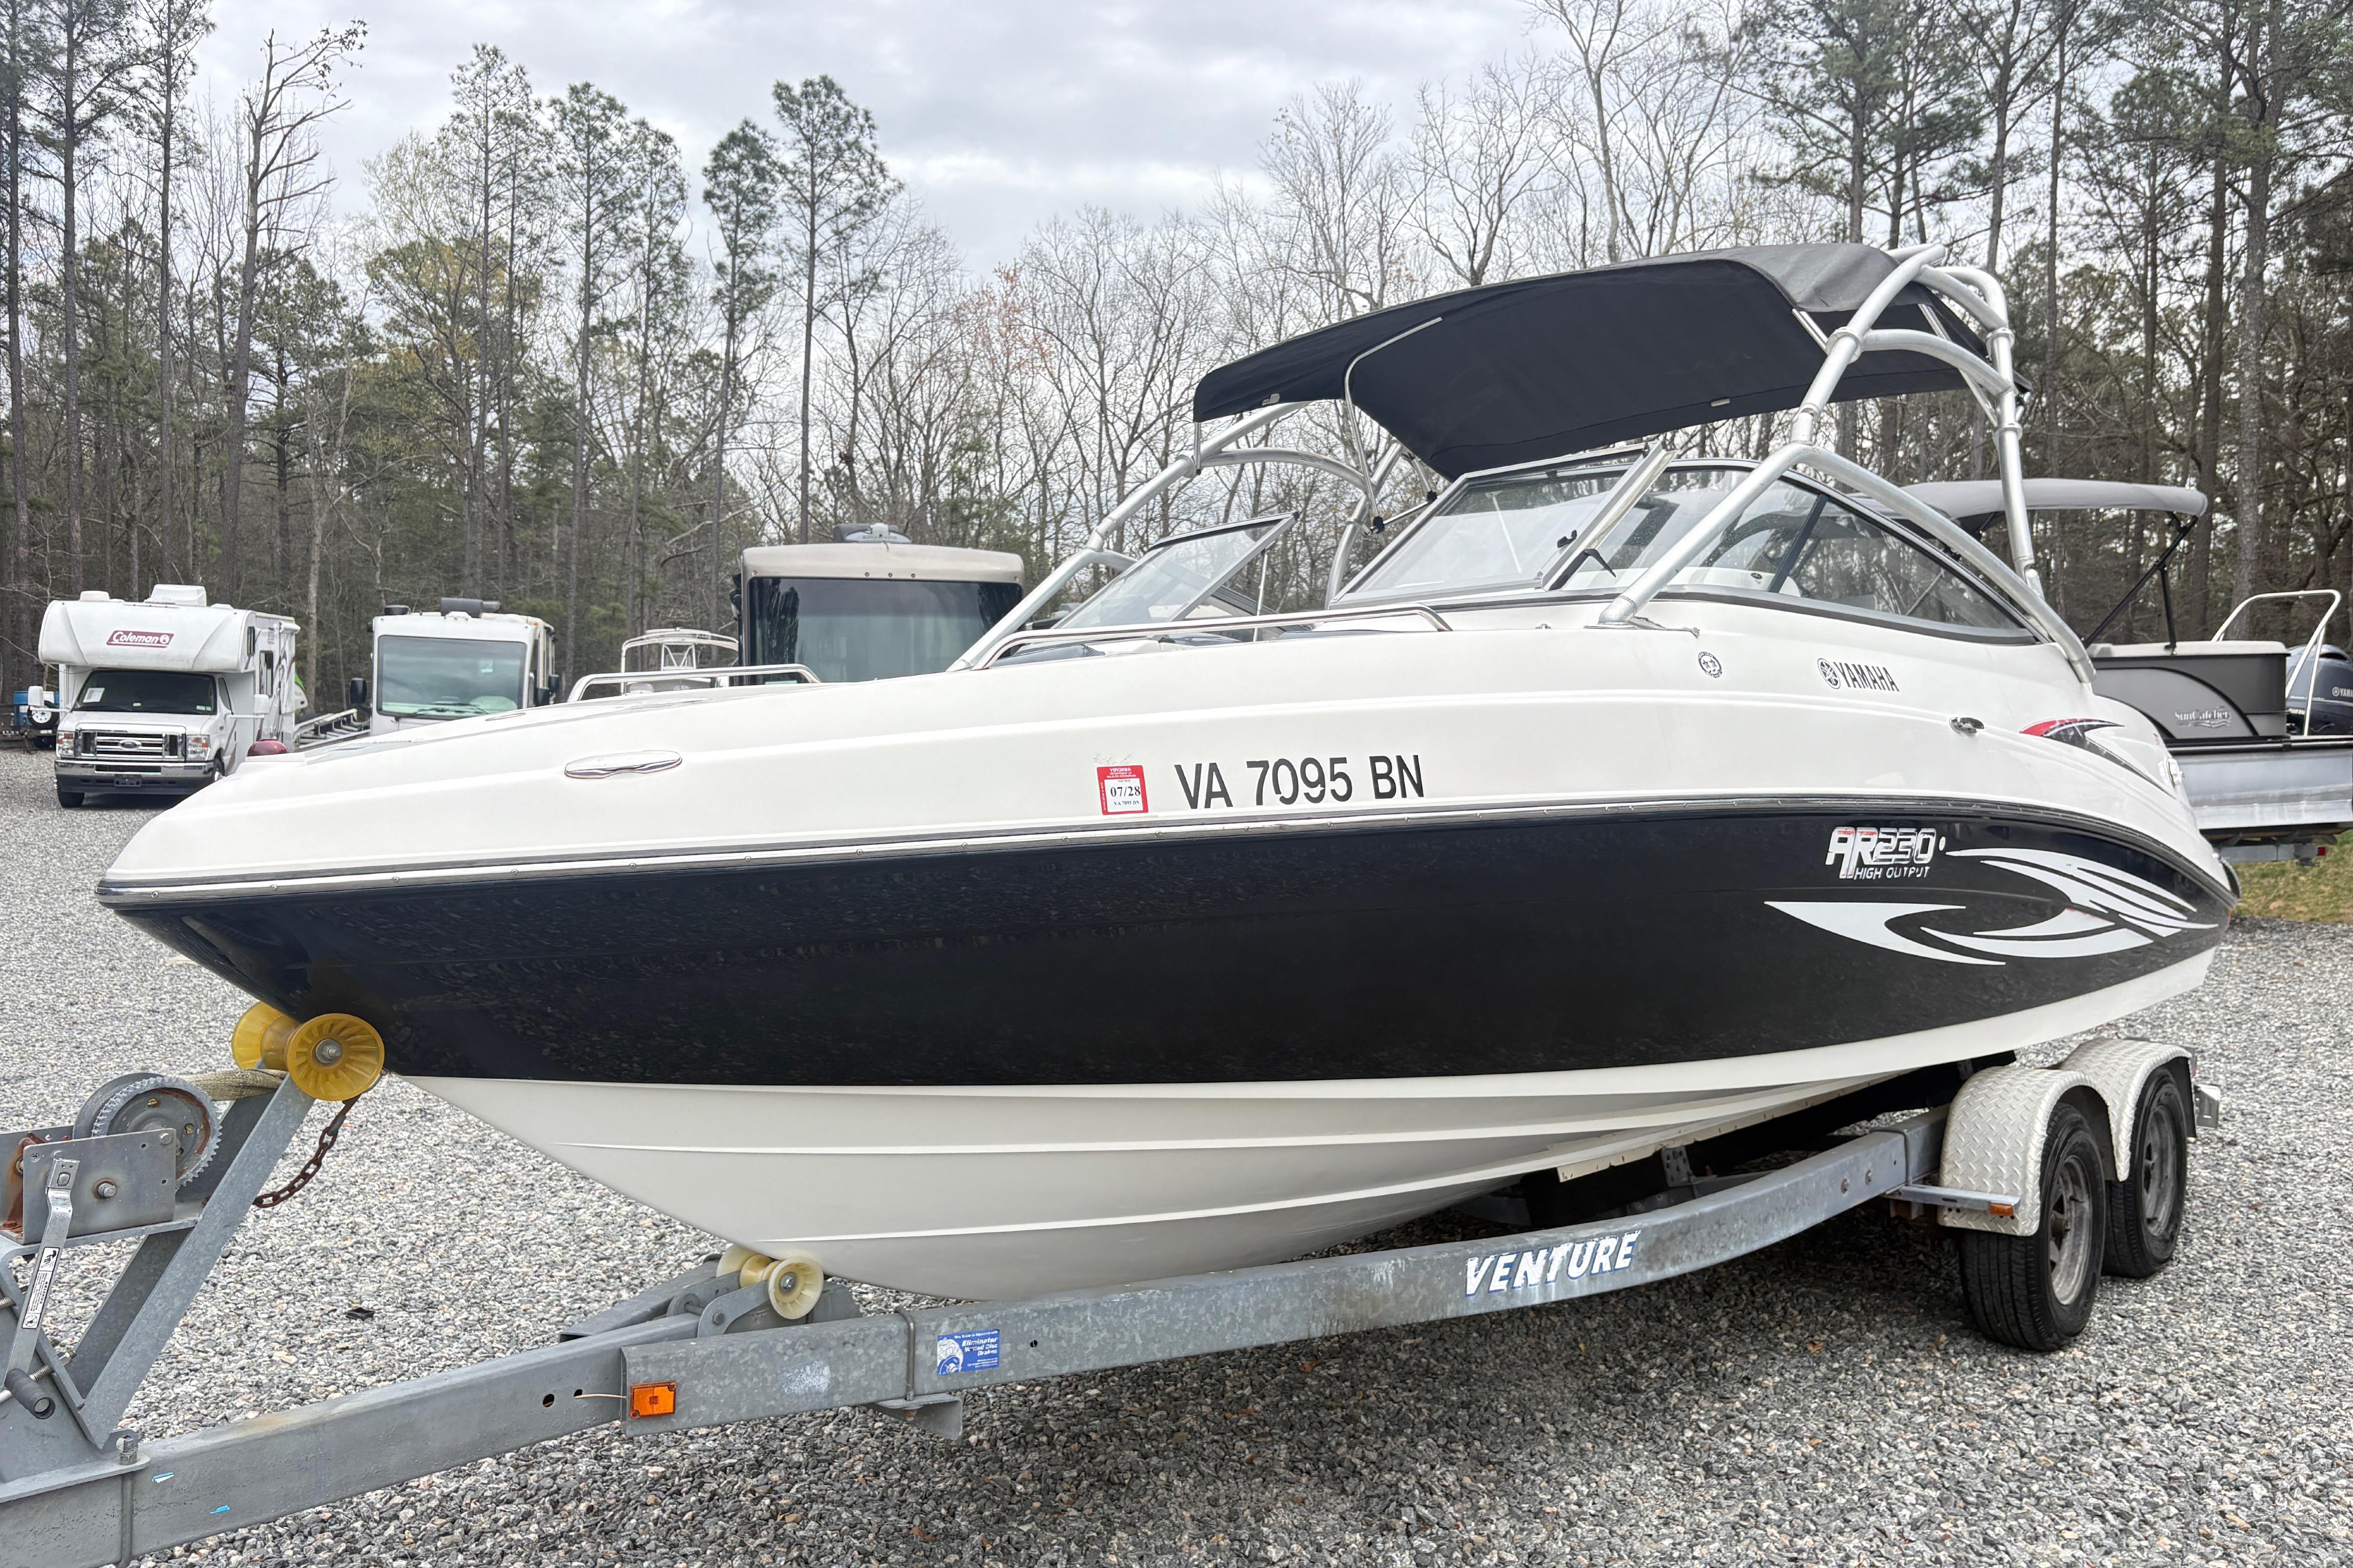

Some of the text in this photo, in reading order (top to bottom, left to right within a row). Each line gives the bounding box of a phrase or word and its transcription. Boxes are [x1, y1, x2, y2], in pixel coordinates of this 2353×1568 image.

[112, 631, 159, 644] Coleman
[1833, 661, 1900, 692] YAMAHA
[1110, 786, 1141, 797] 07/28
[1174, 755, 1425, 809] VA 7095 BN
[1825, 826, 1937, 879] AR230
[1853, 866, 1930, 880] HIGH OUTPUT
[1465, 1230, 1641, 1297] VENTURE
[962, 1337, 998, 1347] Eliminator
